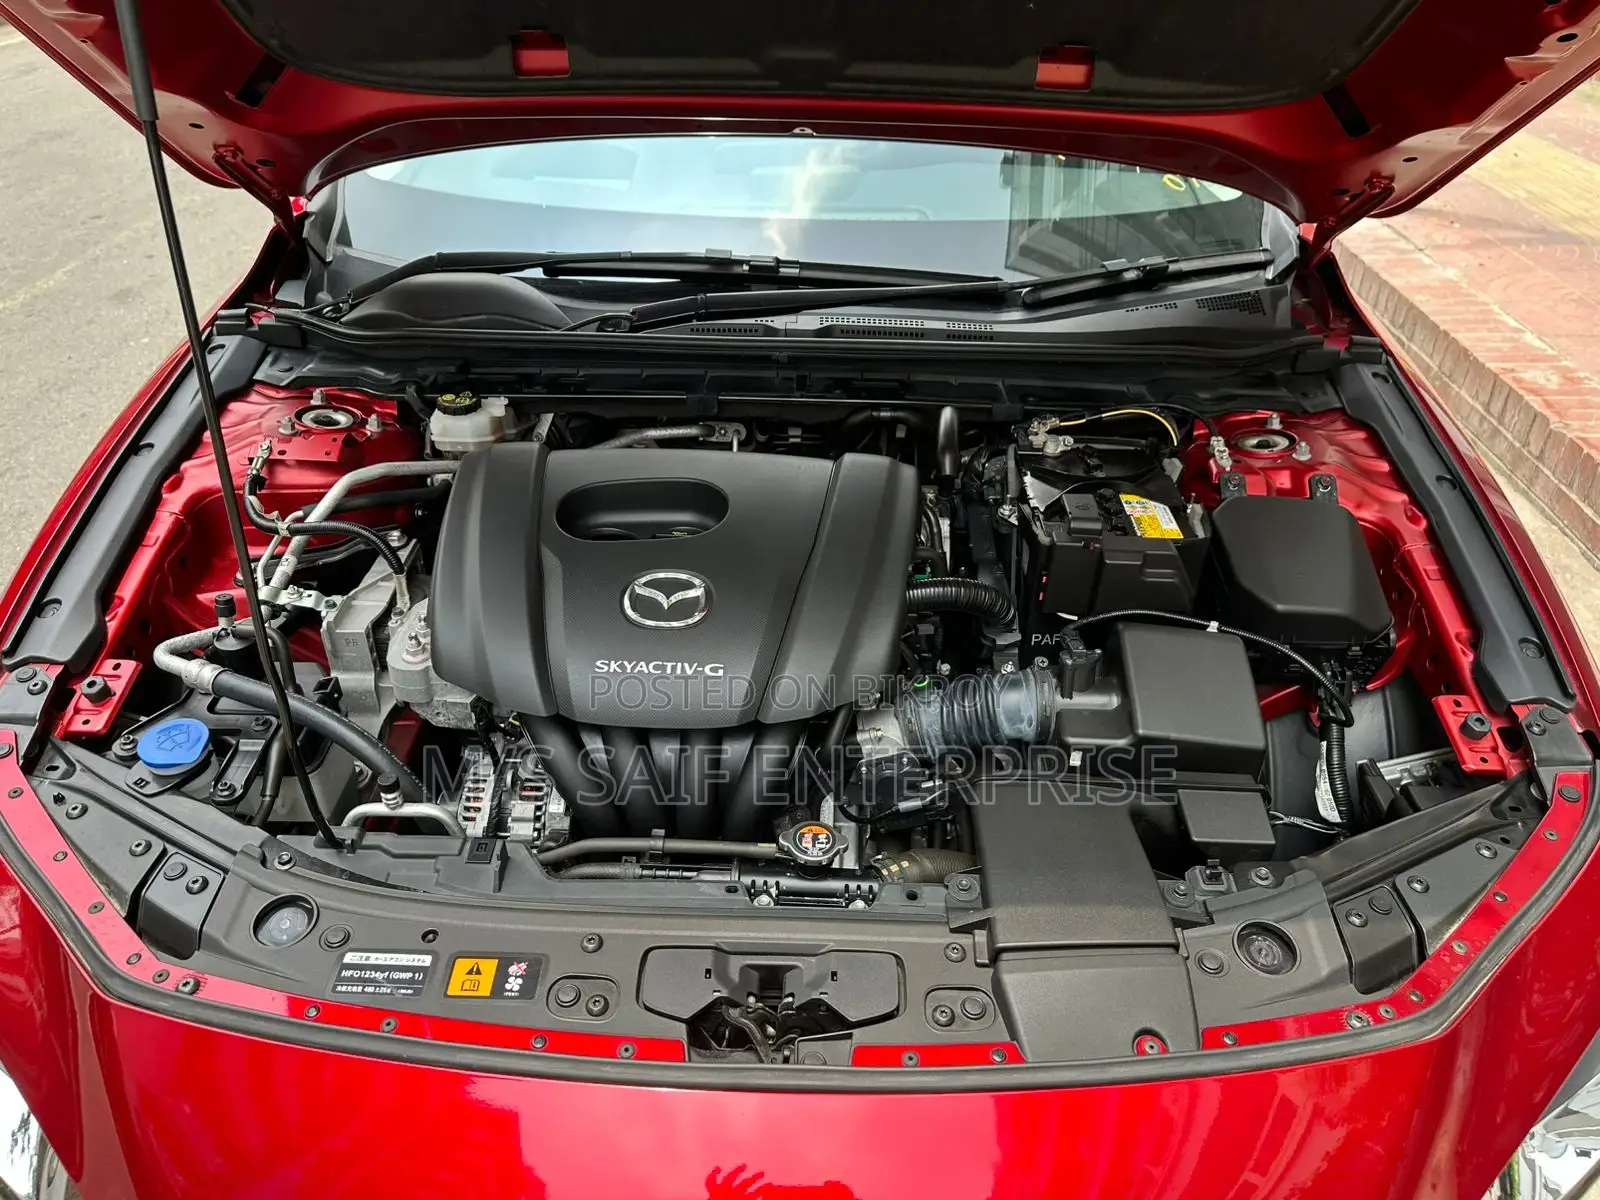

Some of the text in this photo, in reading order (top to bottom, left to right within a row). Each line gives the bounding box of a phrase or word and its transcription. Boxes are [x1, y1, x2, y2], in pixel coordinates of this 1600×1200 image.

[594, 660, 725, 677] SKYACTIV-G
[340, 969, 424, 981] HFO1234yf (GWP 1)
